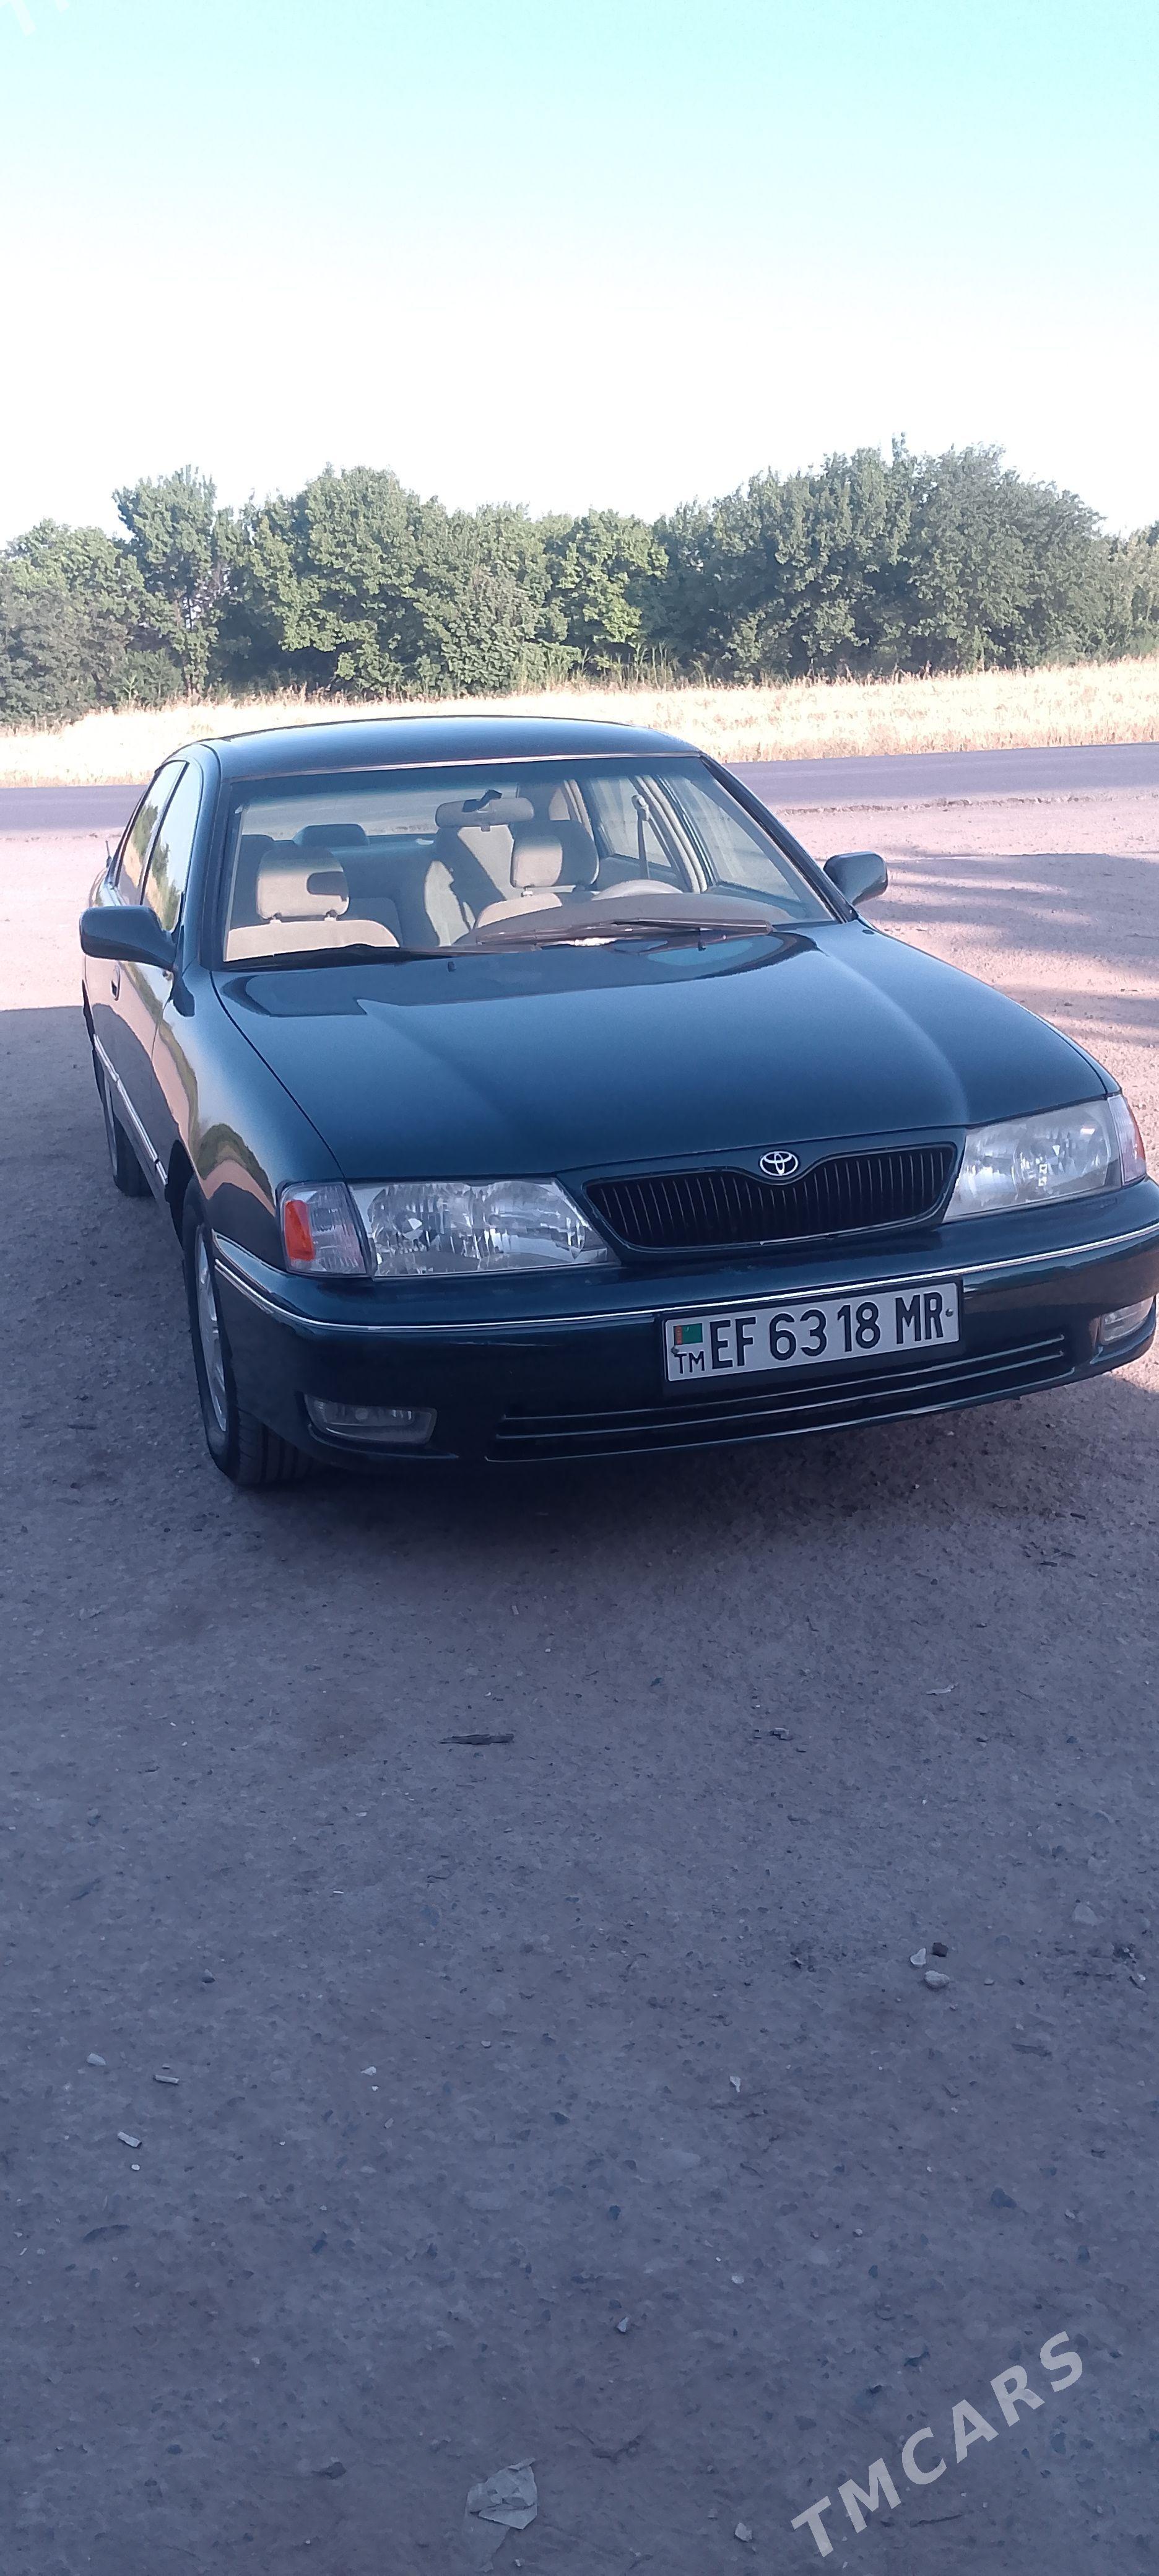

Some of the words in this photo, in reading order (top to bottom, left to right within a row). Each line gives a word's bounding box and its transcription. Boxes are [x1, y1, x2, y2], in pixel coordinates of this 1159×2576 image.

[710, 1316, 757, 1370] EF
[895, 1292, 944, 1345] MR
[676, 1351, 705, 1374] TM
